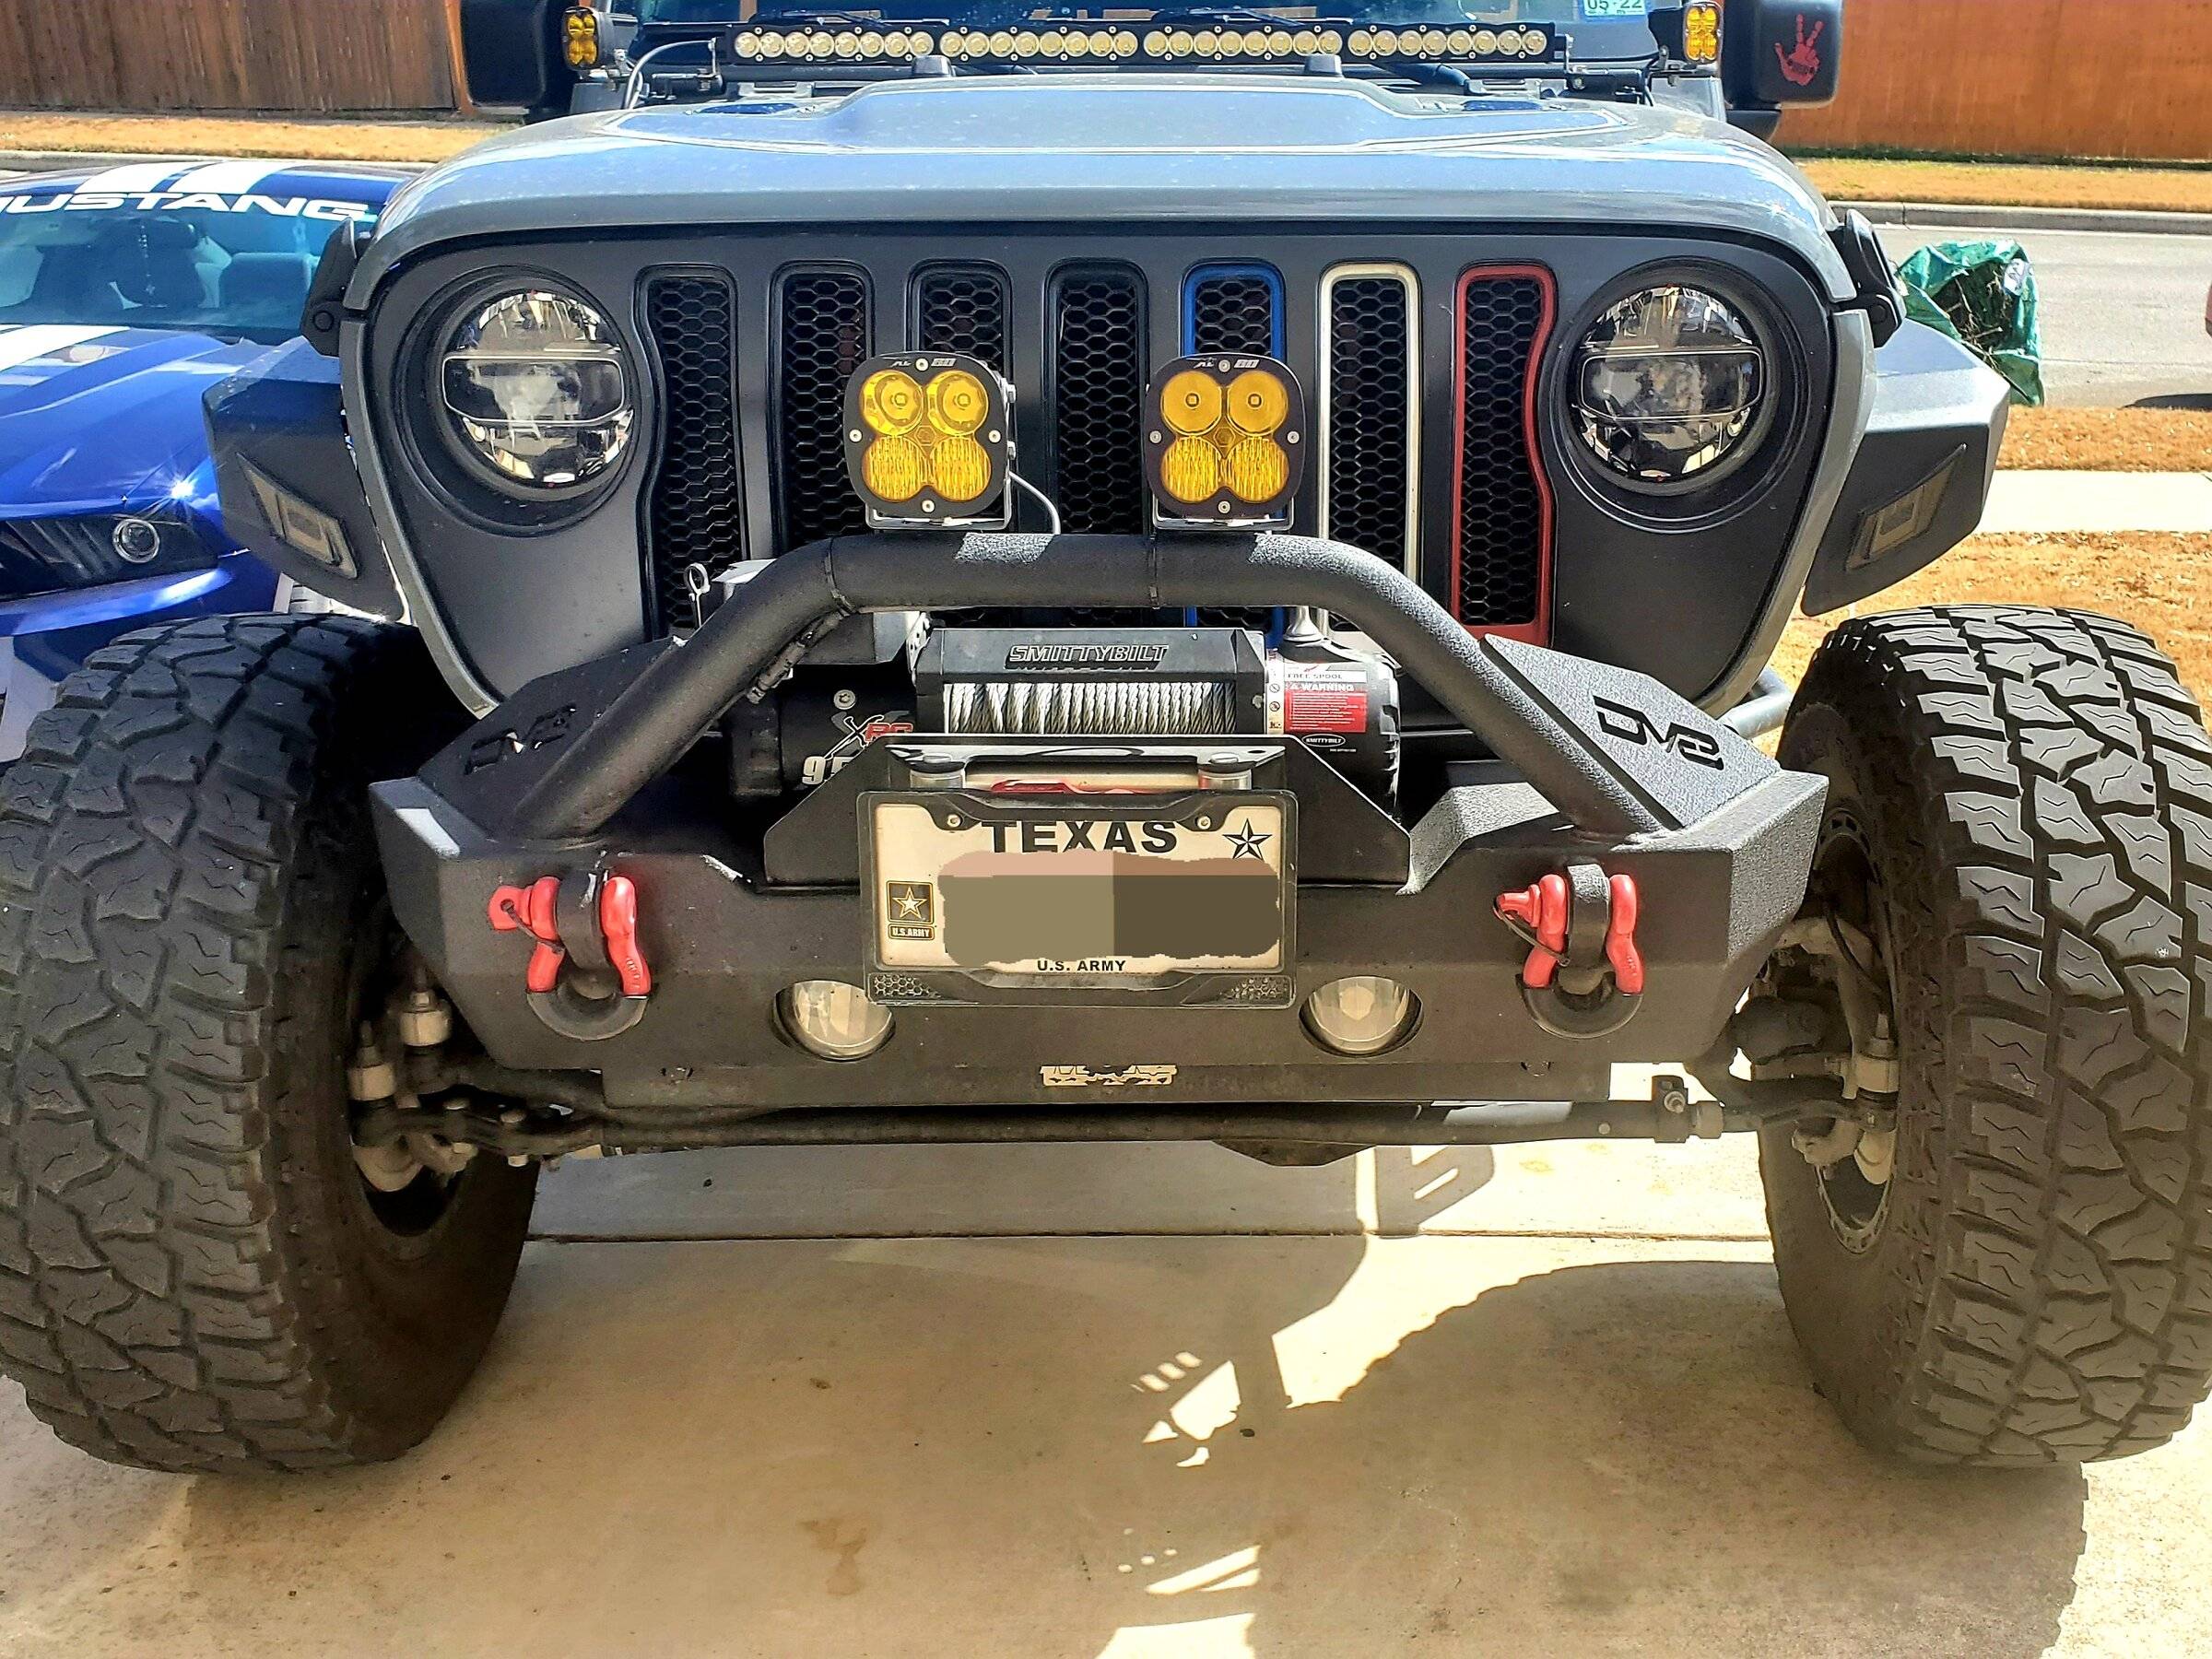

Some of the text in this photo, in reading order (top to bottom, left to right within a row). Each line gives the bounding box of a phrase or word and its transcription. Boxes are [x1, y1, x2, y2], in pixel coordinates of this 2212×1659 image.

[0, 193, 379, 223] USTANG
[1008, 644, 1170, 663] SMITTYBILT
[1300, 682, 1355, 692] WARNING
[982, 821, 1177, 853] TEXAS
[1037, 959, 1126, 971] U.S. ARMY
